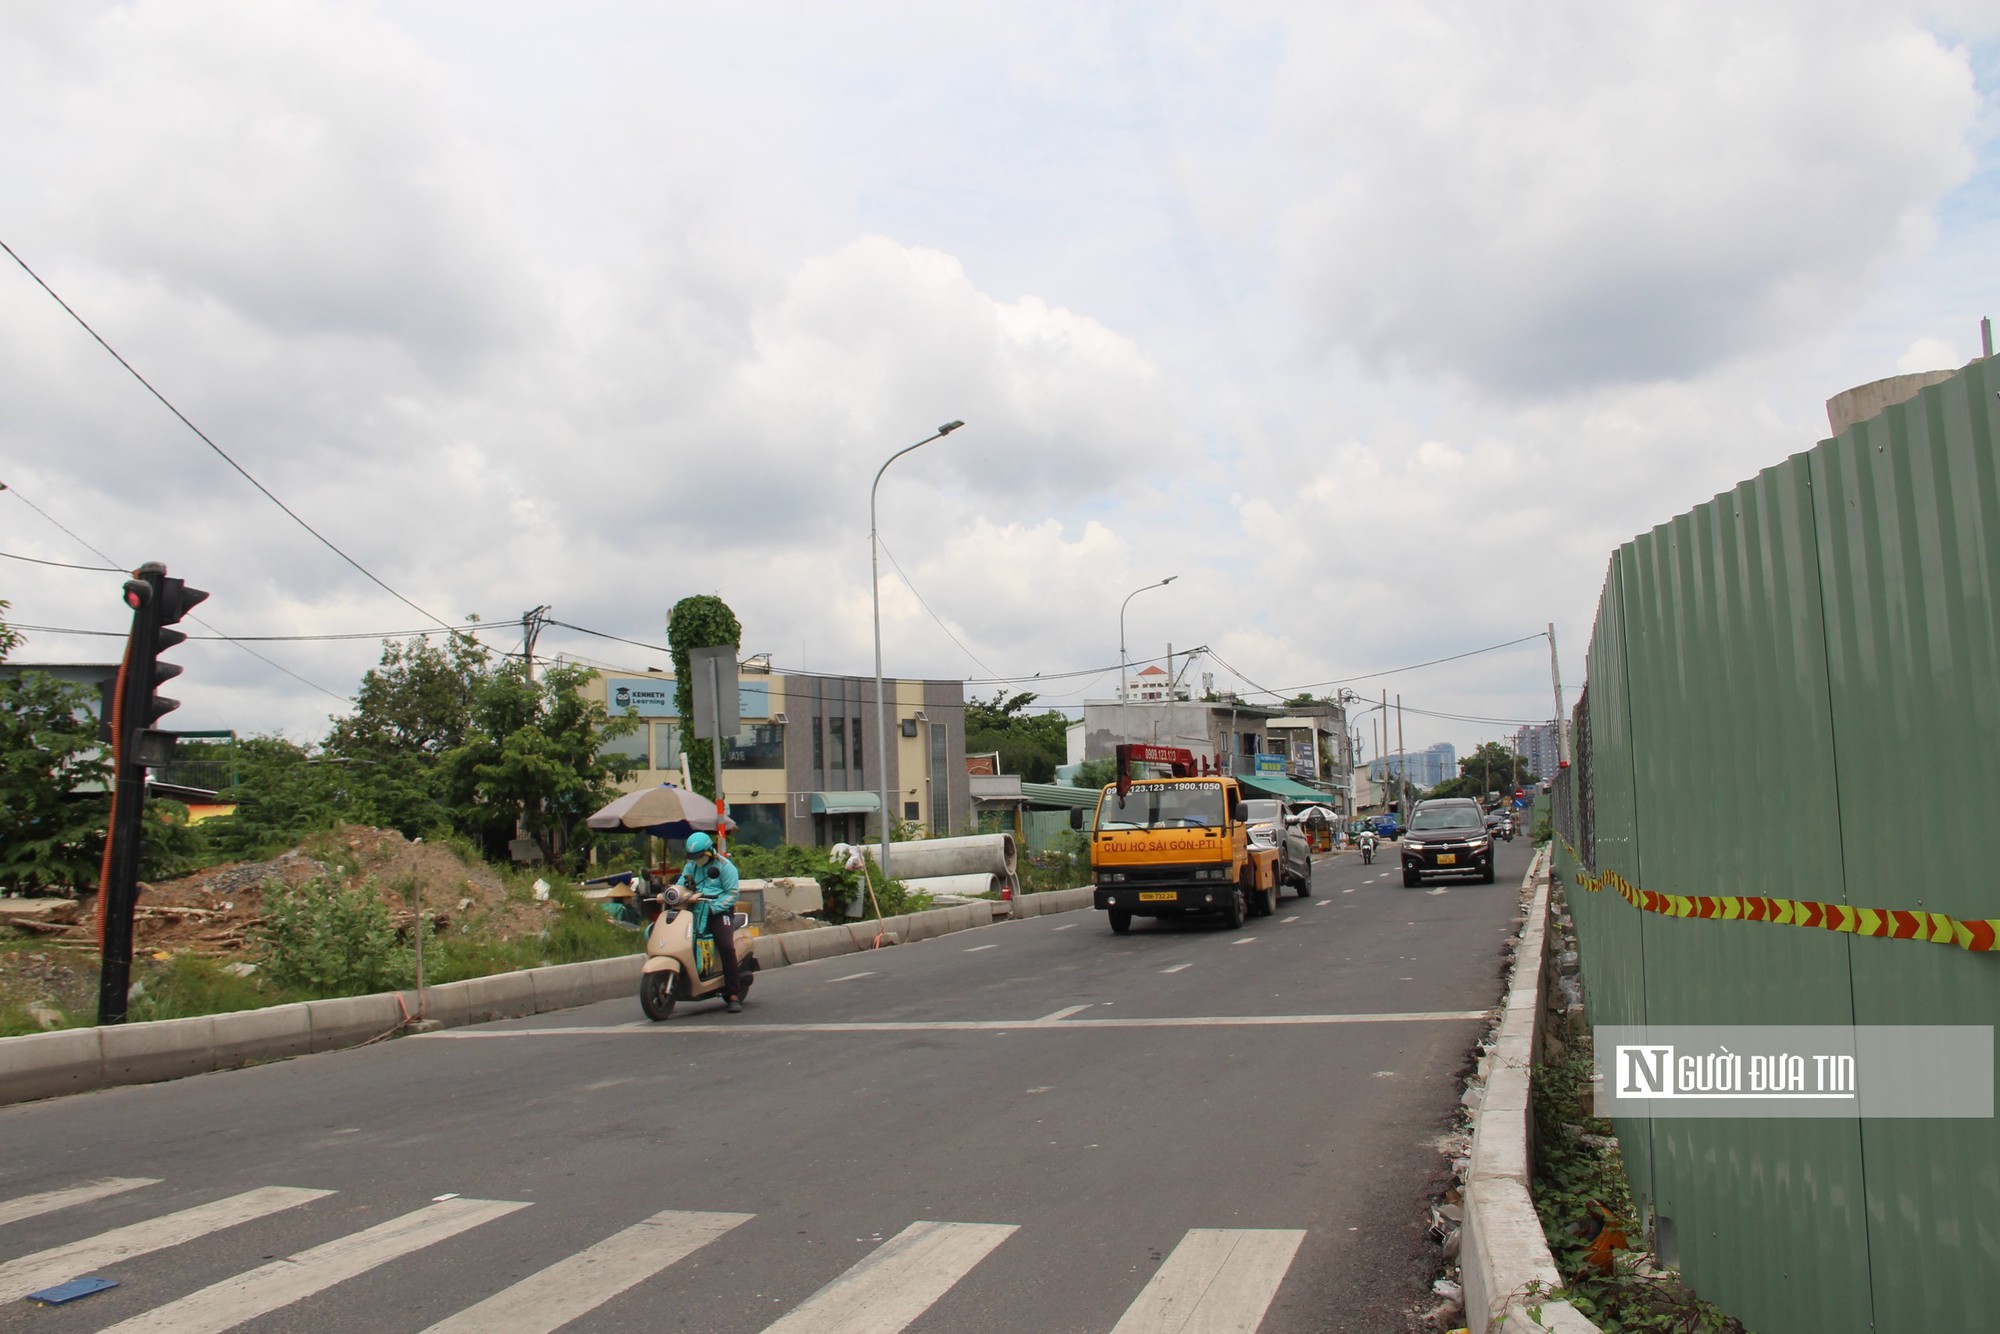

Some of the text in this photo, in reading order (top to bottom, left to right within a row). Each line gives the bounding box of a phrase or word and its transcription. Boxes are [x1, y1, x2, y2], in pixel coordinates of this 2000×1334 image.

[632, 698, 665, 706] Learning
[1106, 783, 1165, 795] 09.123.123
[1174, 783, 1220, 791] 1900.1050
[1149, 839, 1167, 851] SÀI
